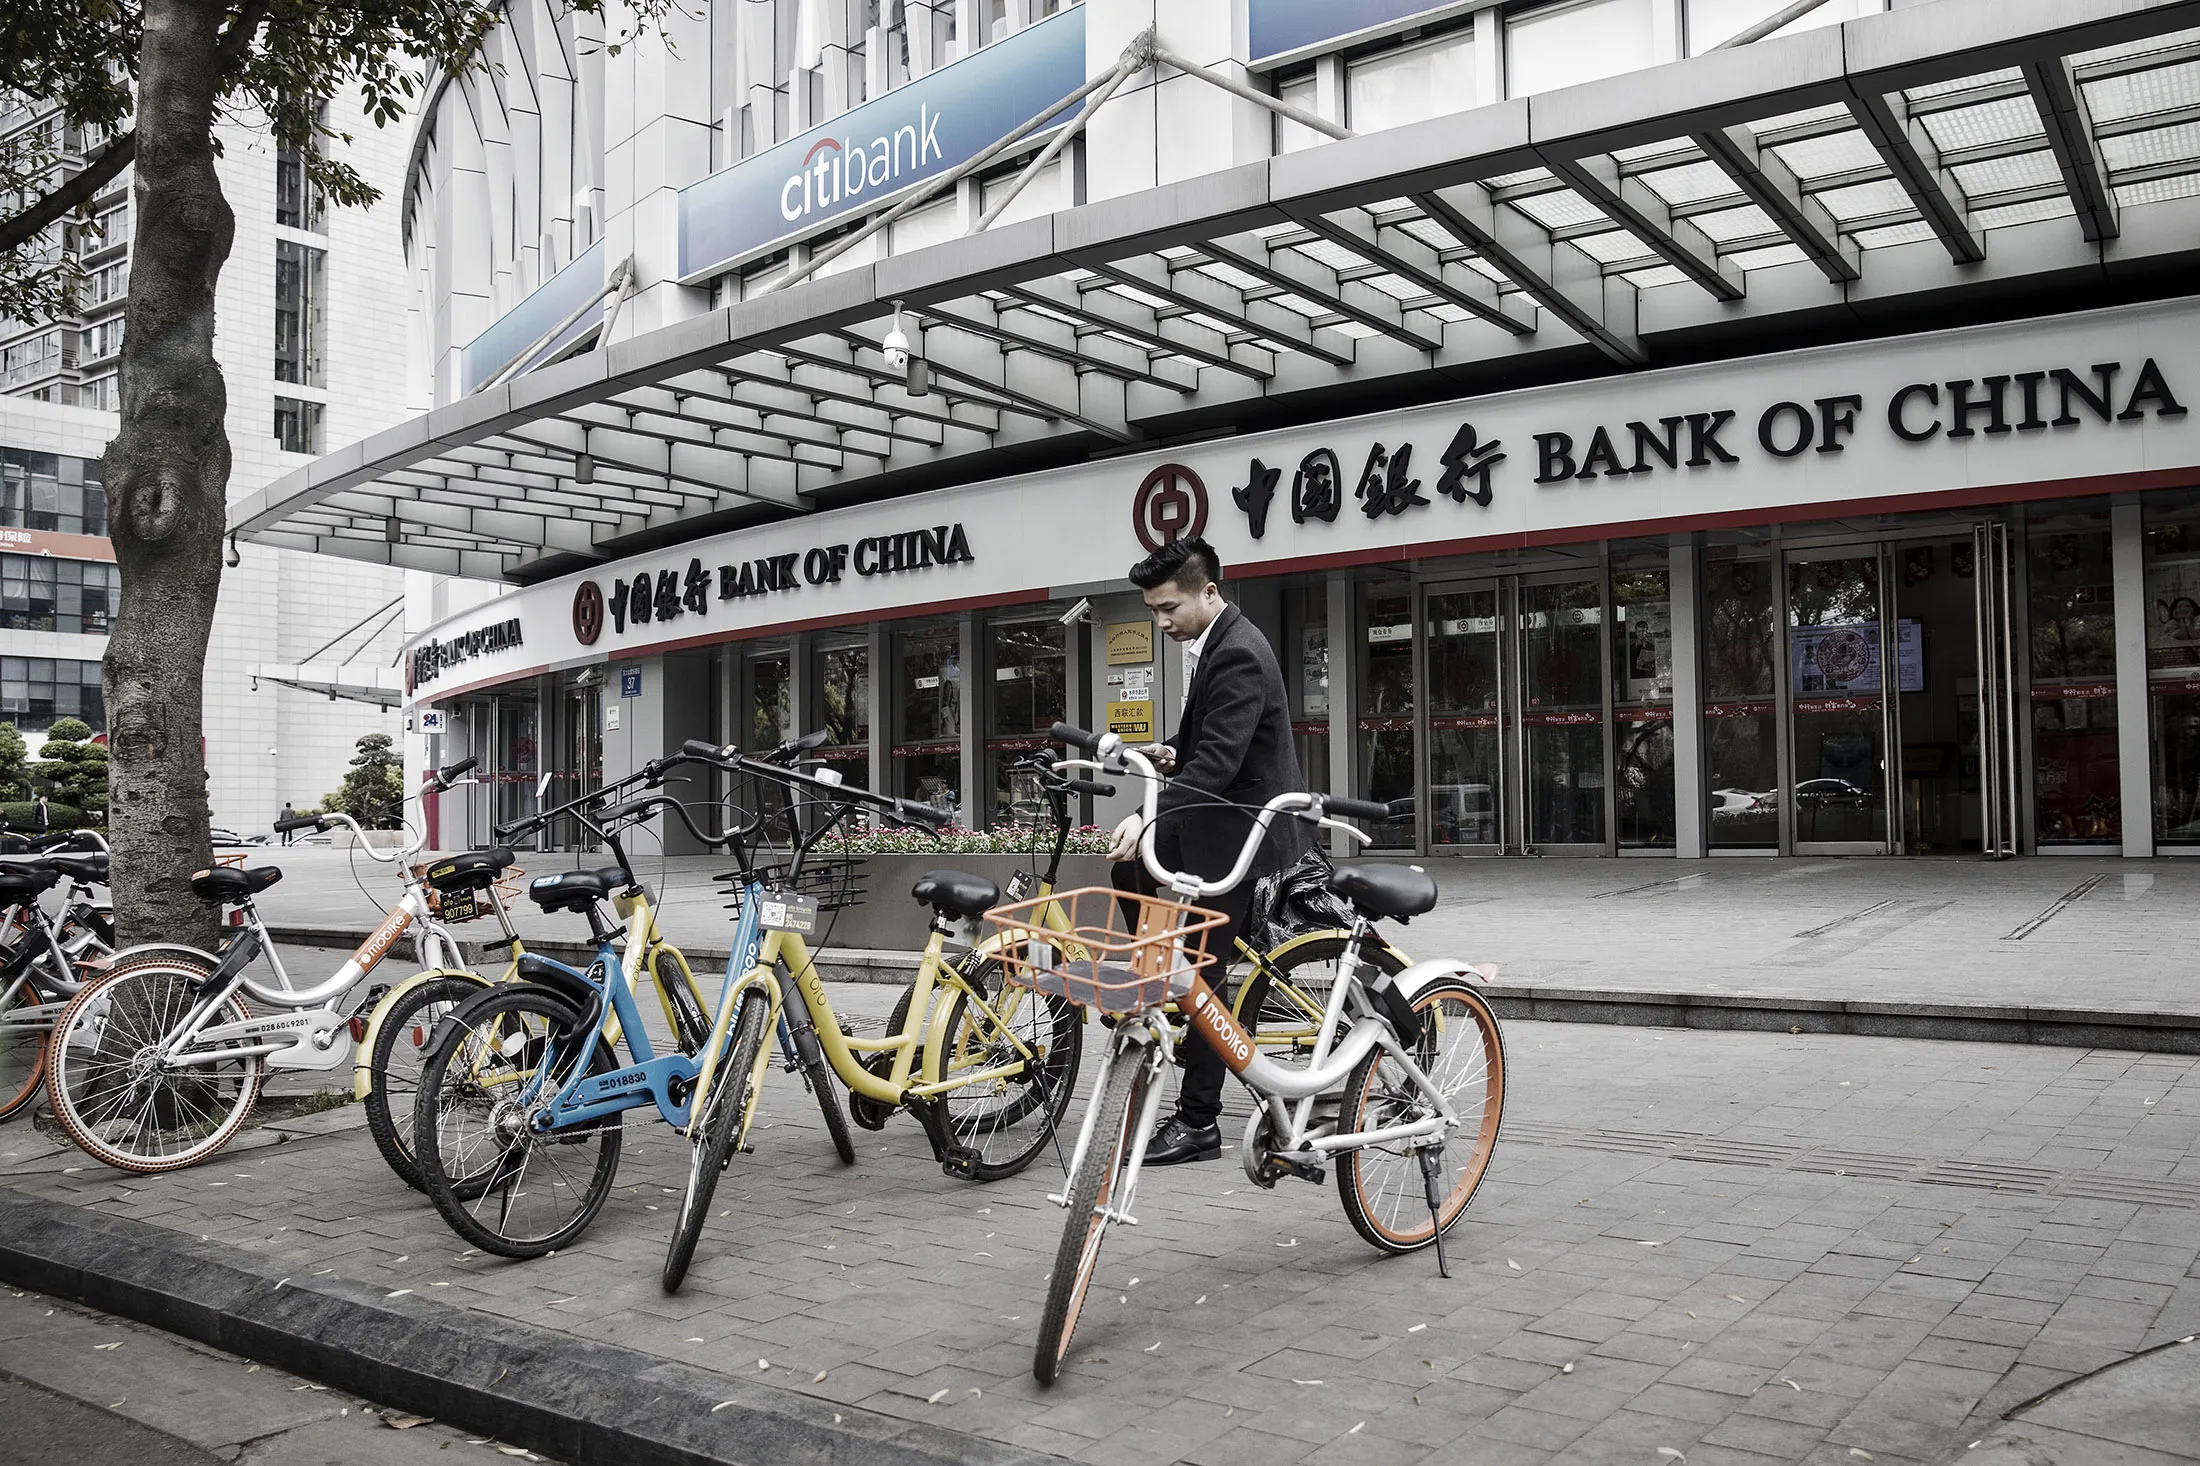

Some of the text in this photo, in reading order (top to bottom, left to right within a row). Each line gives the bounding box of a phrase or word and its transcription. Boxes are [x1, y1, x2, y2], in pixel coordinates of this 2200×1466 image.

[781, 102, 942, 222] citibank
[1531, 357, 2188, 485] BANK OF CHINA
[1231, 422, 1507, 540] 中国银行
[718, 522, 975, 601] BANK OF CHINA
[608, 557, 711, 634] 中国银行
[480, 617, 523, 654] CHINA
[627, 676, 636, 690] 37
[1114, 707, 1144, 718] 西联汇款
[444, 903, 473, 920] 907799
[368, 915, 405, 957] mobike
[726, 942, 757, 1036] bluego
[809, 977, 827, 1006] ofo
[261, 1018, 309, 1032] 0286049201
[1202, 1002, 1249, 1060] mobike
[610, 1071, 647, 1088] 018830
